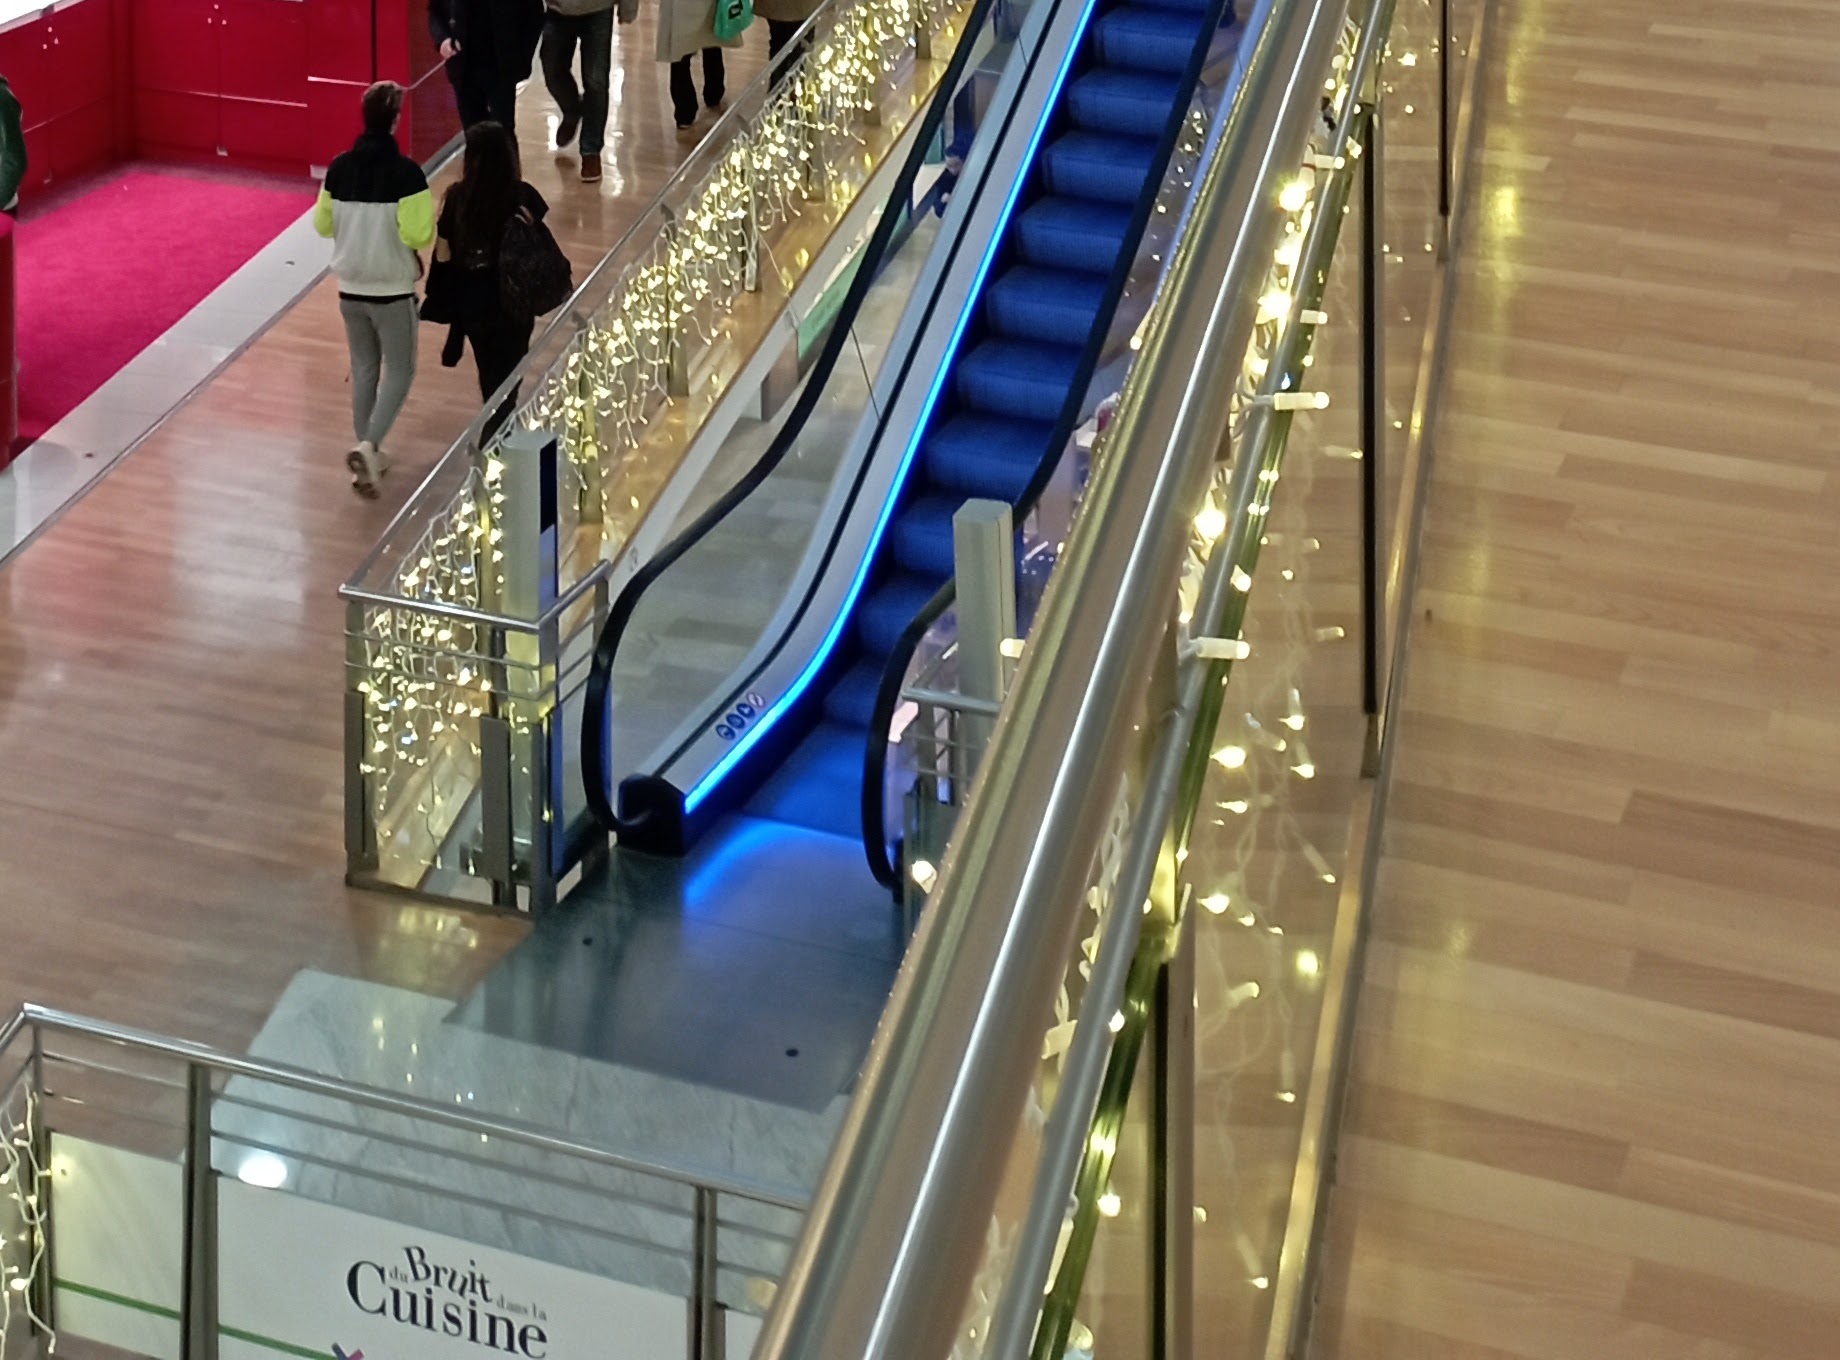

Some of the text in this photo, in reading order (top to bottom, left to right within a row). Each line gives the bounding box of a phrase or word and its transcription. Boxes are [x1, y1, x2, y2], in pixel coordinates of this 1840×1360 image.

[346, 1259, 549, 1360] Cuisine
[389, 1245, 548, 1322] du Bruit dans la
